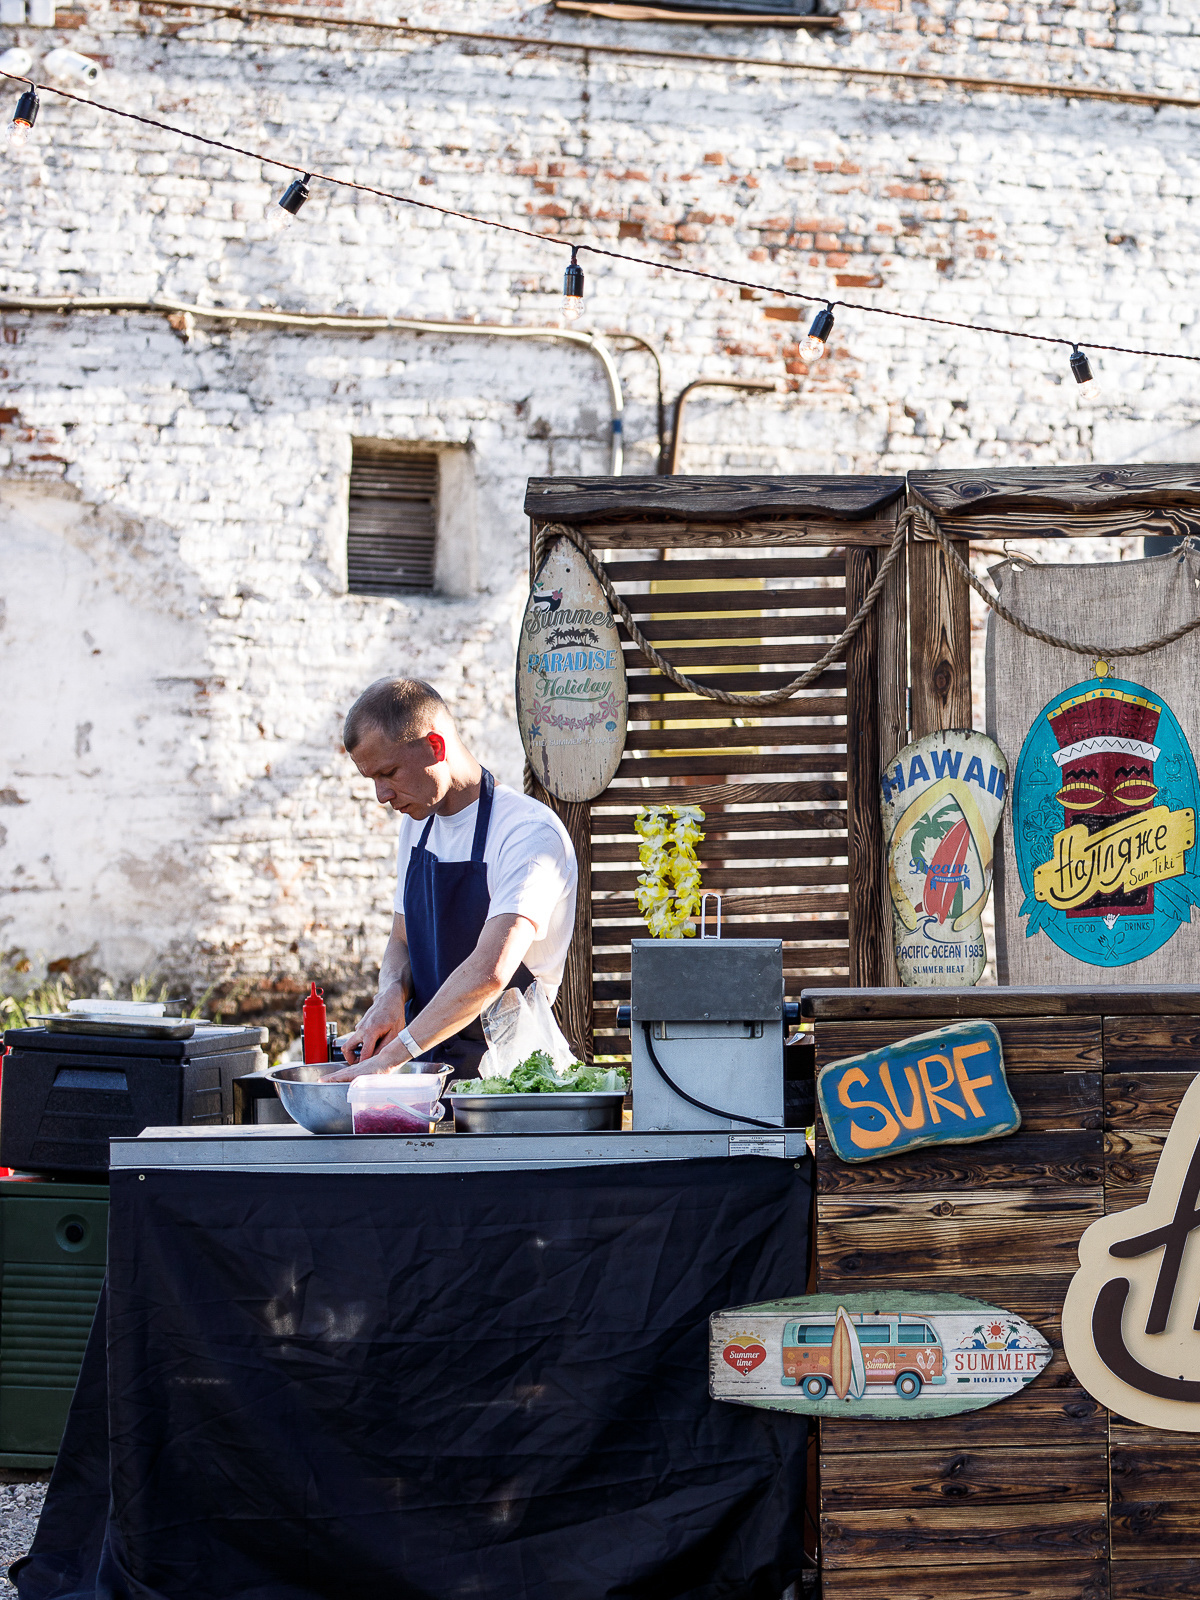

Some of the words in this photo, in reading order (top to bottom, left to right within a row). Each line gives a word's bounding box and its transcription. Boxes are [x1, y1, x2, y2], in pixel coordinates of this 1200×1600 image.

[525, 606, 616, 640] Summer
[528, 650, 617, 673] PARADISE
[535, 677, 613, 703] Holiday
[881, 751, 1006, 803] HAWAII
[909, 857, 970, 875] Dream
[1128, 854, 1175, 886] Sun-Tiki
[1073, 924, 1096, 934] FOOD
[1124, 921, 1151, 932] DRINKS
[896, 945, 929, 959] PACIFIC
[932, 945, 961, 959] OCEAN
[965, 944, 985, 958] 1983
[912, 965, 944, 974] SUMMER
[946, 965, 965, 974] HEAT
[838, 1041, 993, 1149] SURF
[729, 1350, 761, 1360] Summer
[736, 1359, 752, 1367] time
[954, 1352, 1038, 1371] SUMMER
[865, 1360, 897, 1370] Summer
